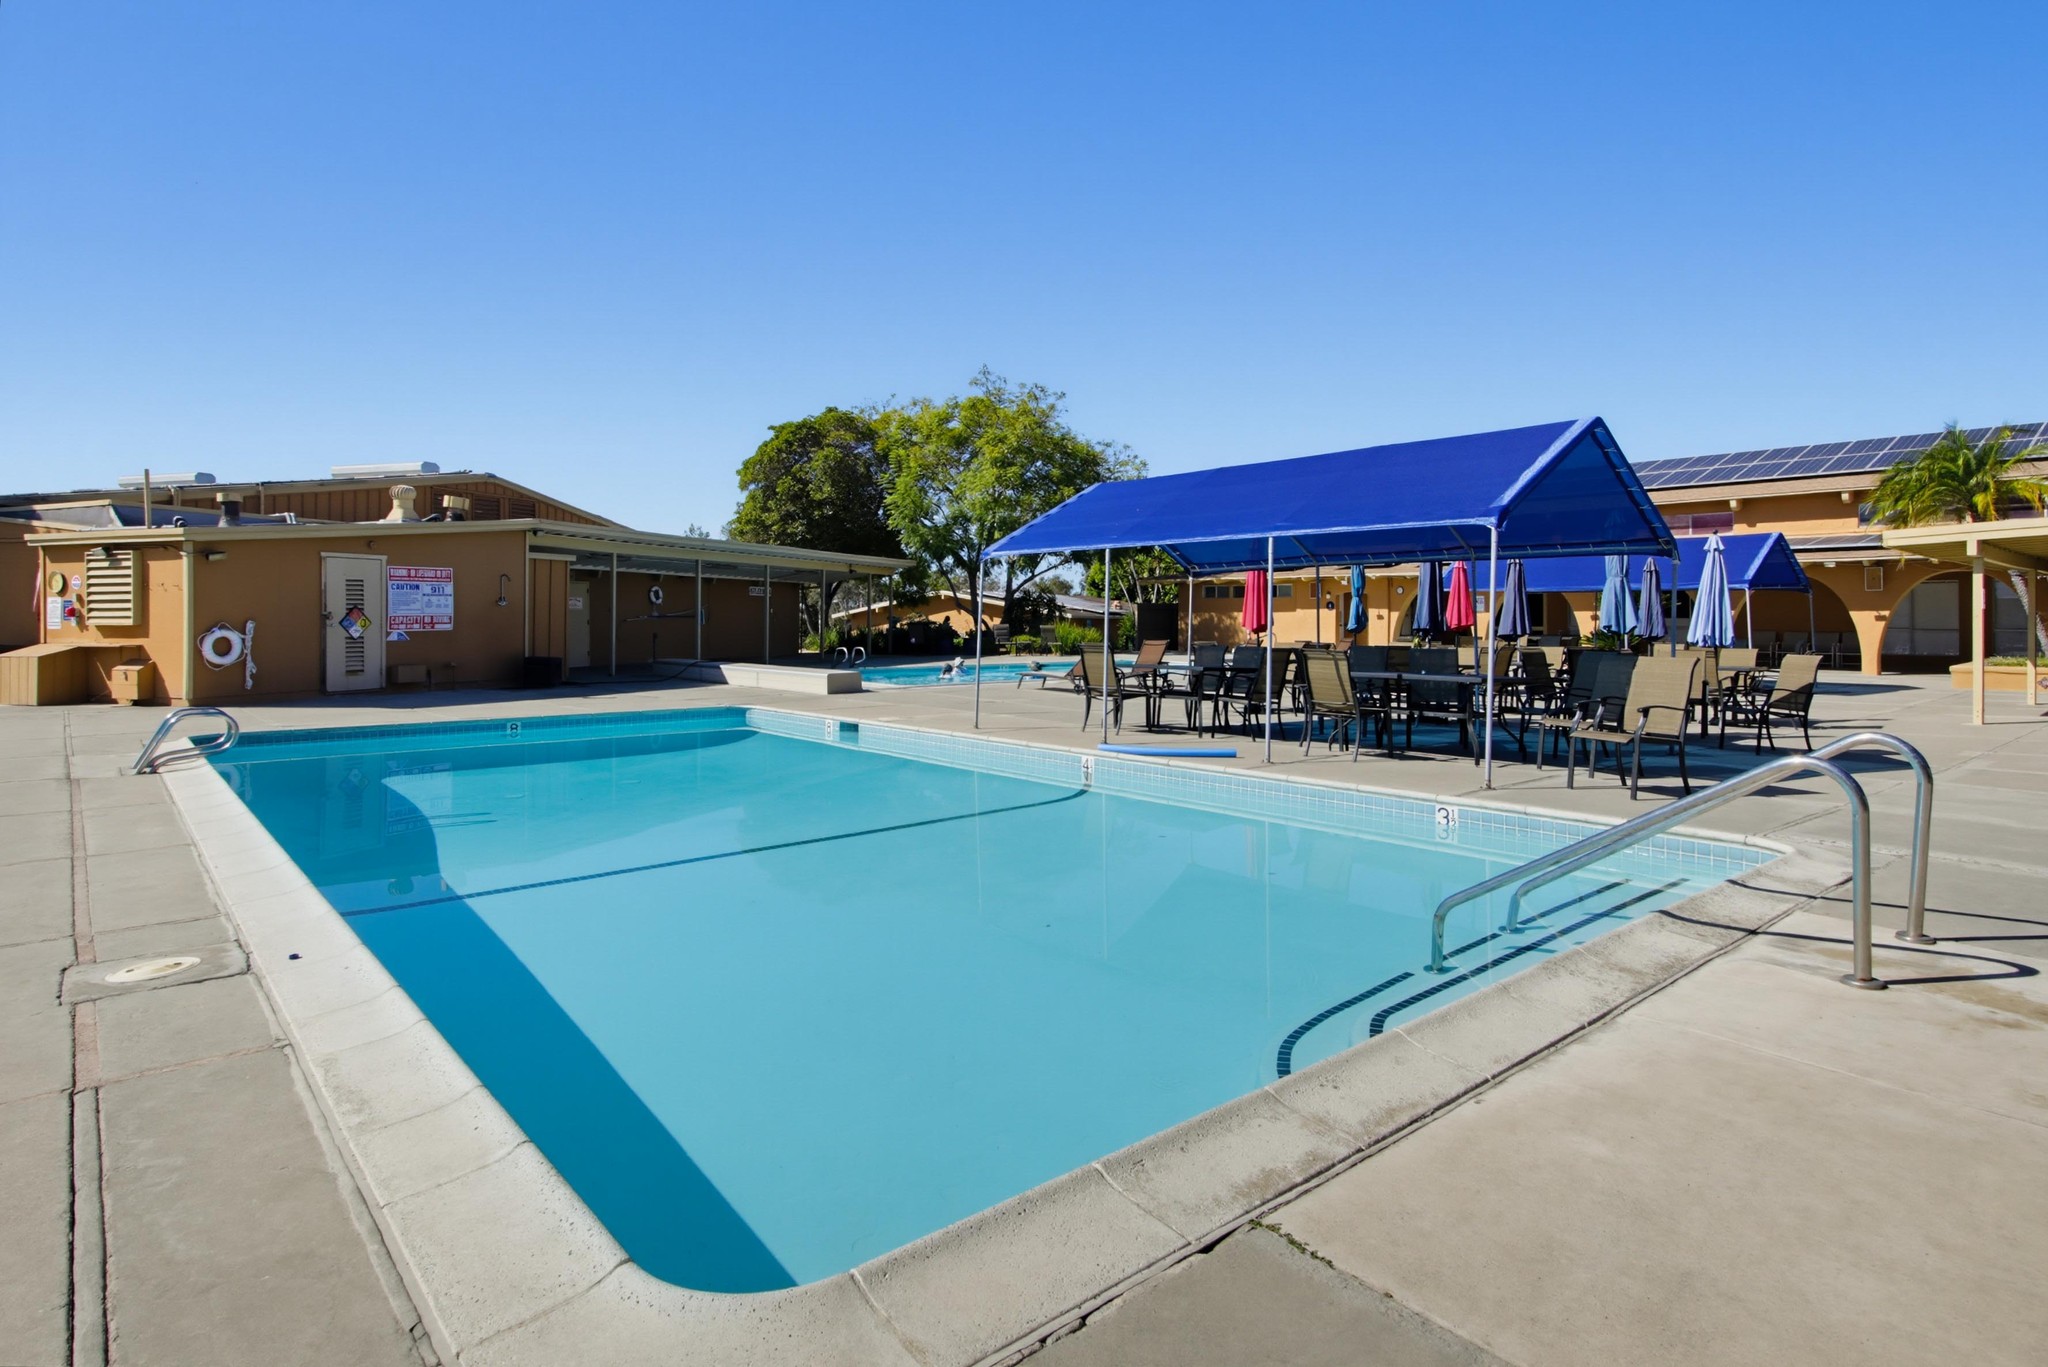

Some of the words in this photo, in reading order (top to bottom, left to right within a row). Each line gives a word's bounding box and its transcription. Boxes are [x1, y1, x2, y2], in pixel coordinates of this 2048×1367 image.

[391, 583, 420, 591] CAUTION
[431, 586, 445, 594] 911
[390, 616, 420, 624] CAPACITY
